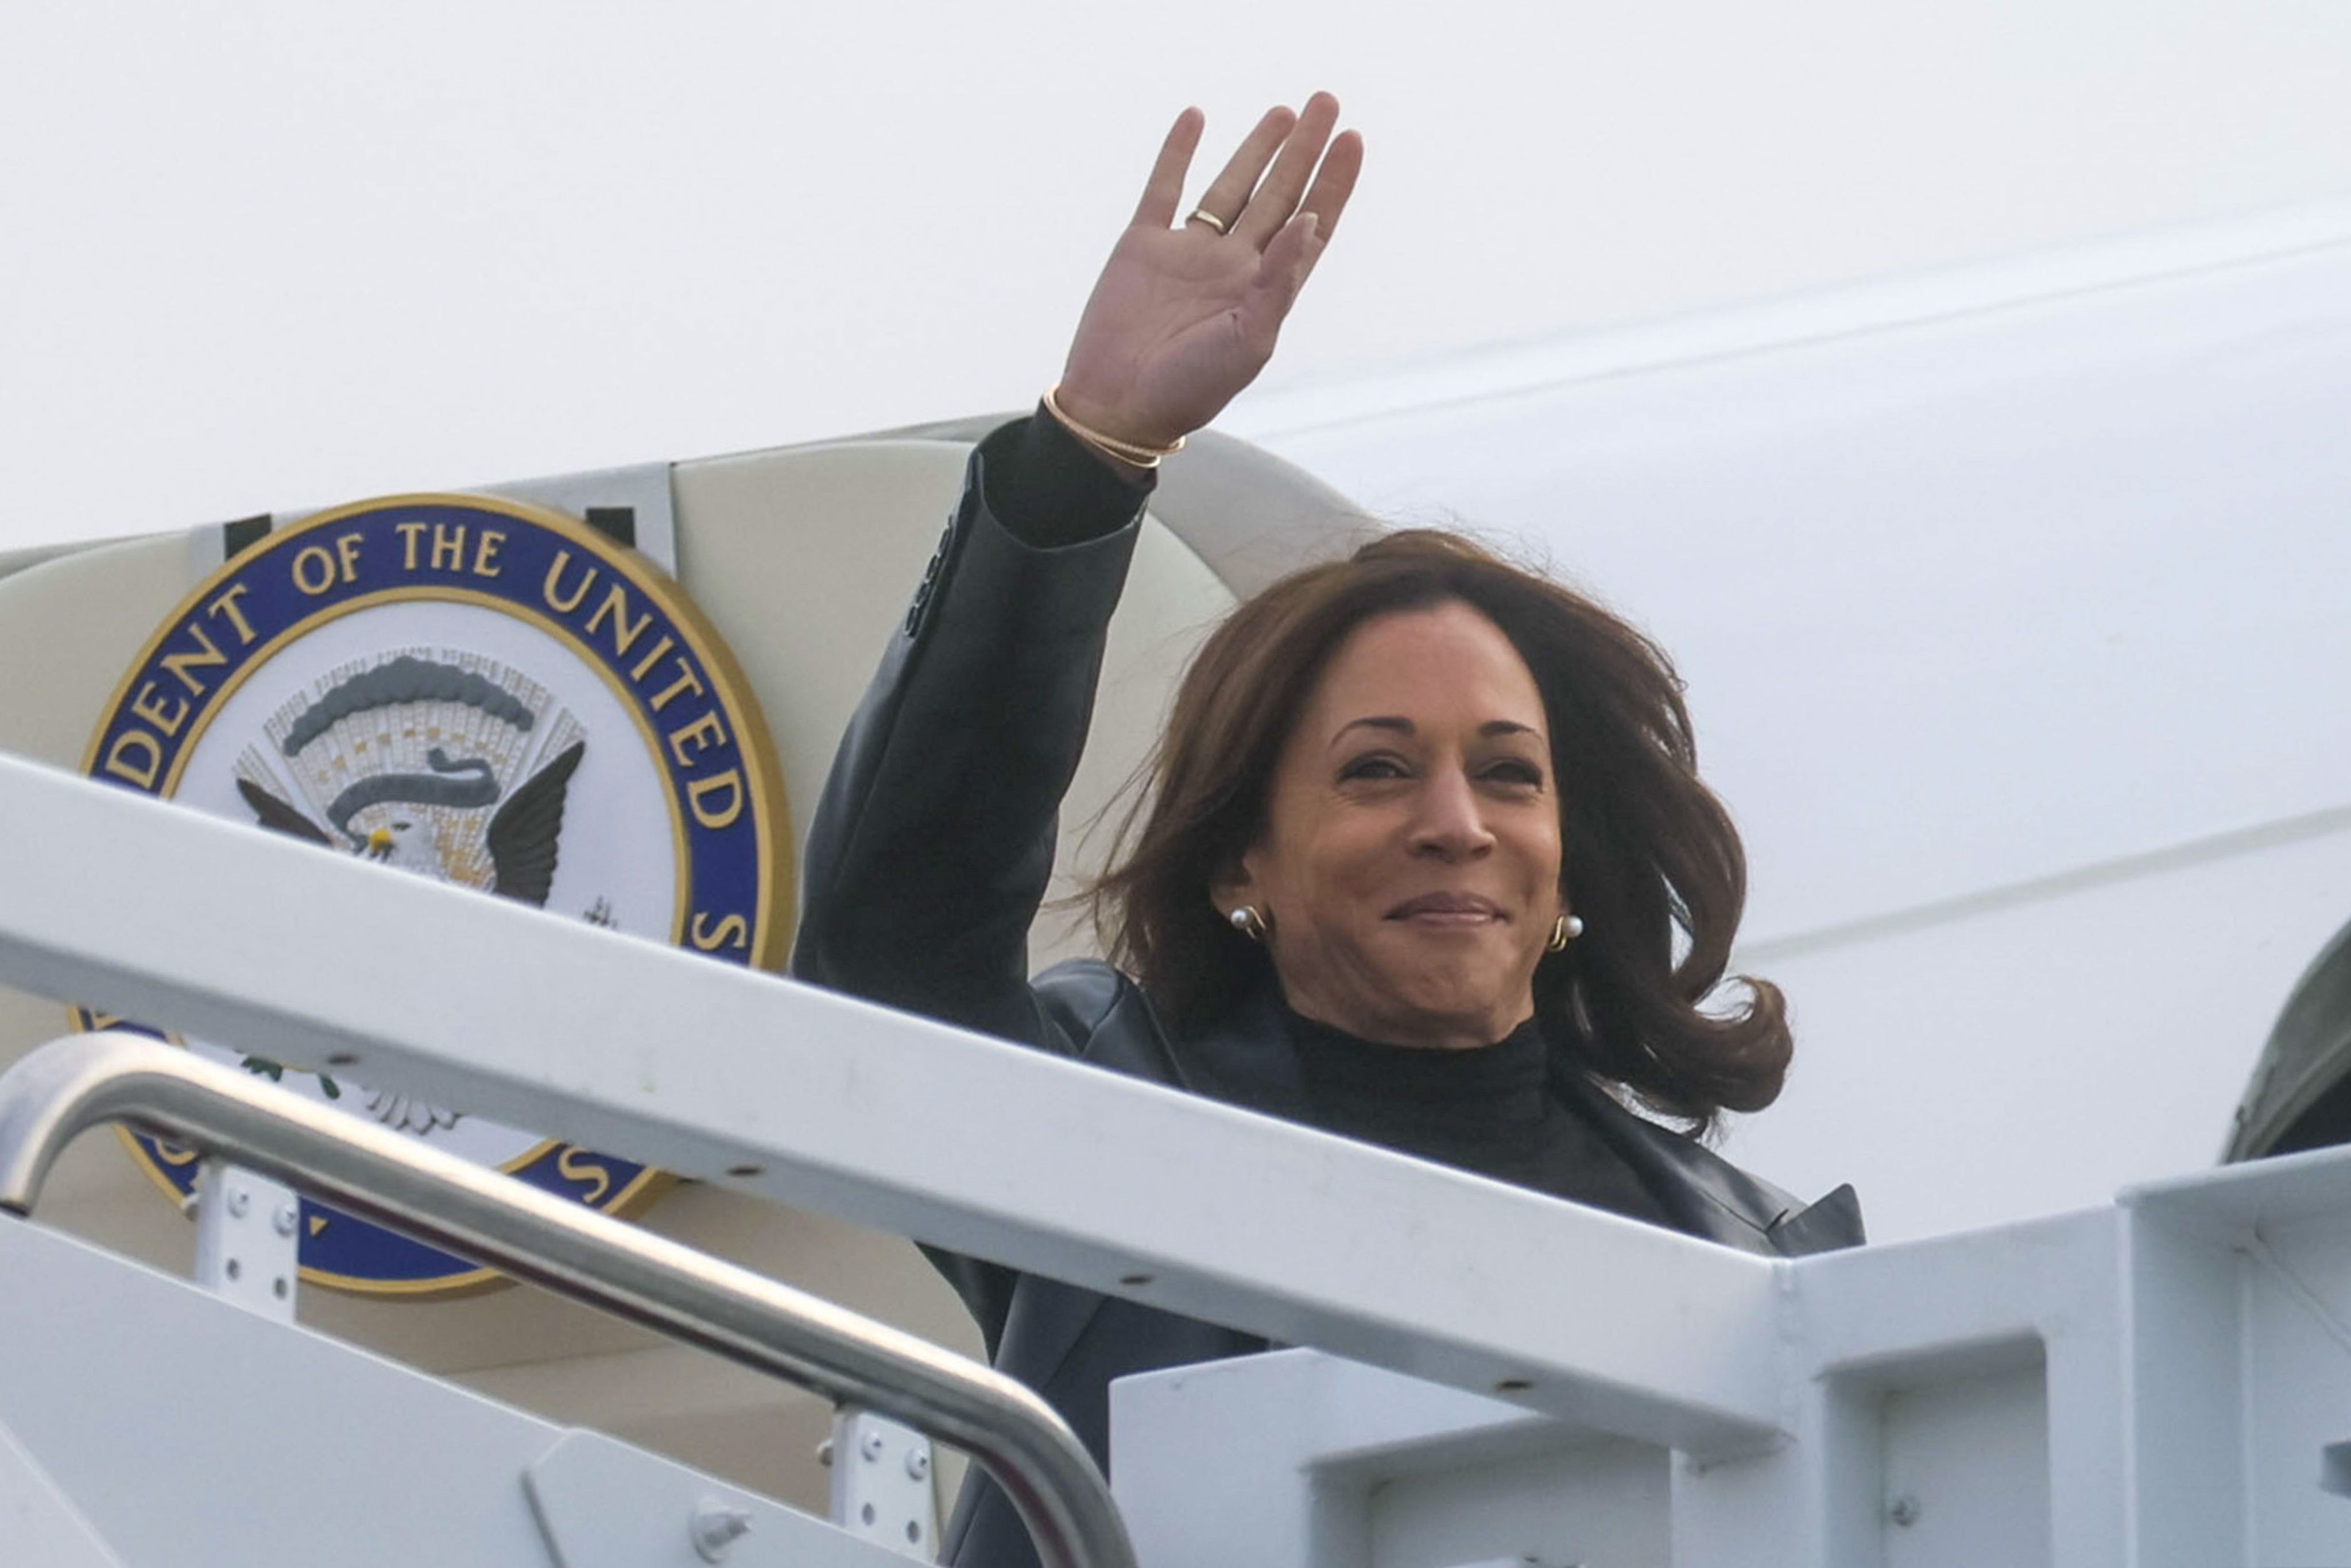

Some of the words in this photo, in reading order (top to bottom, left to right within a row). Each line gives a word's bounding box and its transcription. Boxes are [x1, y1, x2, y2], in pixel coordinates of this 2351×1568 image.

[292, 533, 364, 596] OF
[395, 523, 507, 577] THE
[543, 550, 746, 830] UNITED
